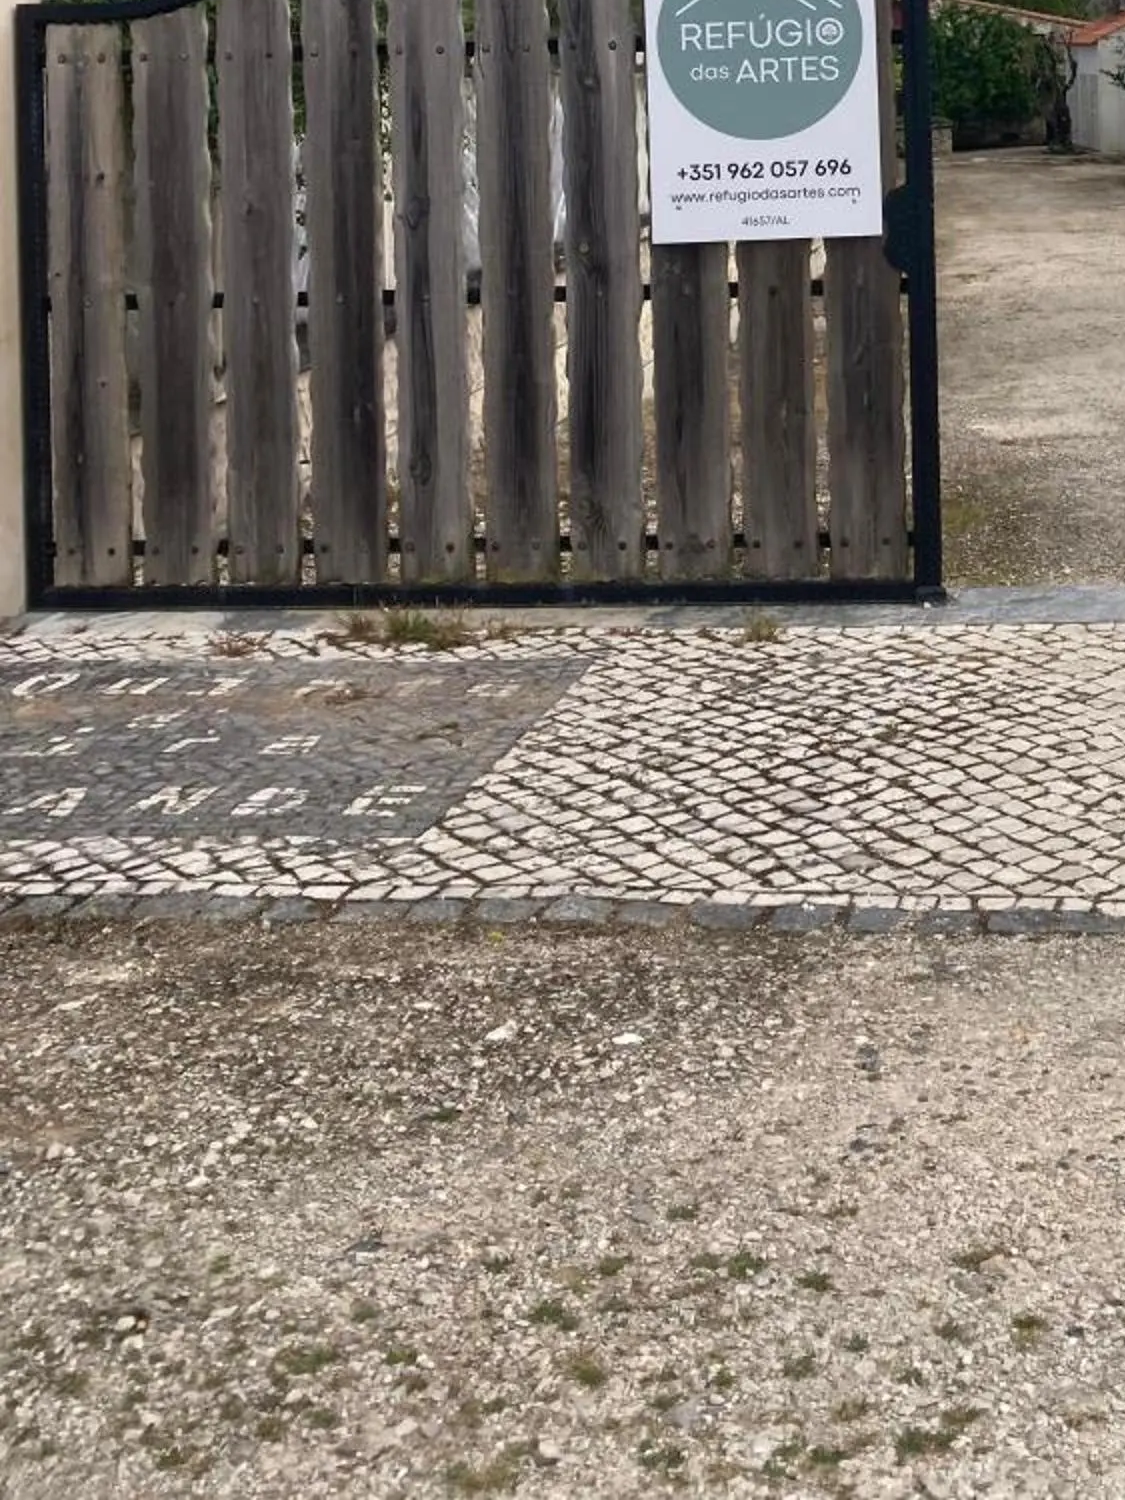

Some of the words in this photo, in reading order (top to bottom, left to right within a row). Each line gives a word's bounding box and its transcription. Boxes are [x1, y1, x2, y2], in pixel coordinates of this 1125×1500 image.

[680, 13, 844, 51] REFÚGIO
[690, 63, 729, 81] das
[735, 55, 840, 84] ARTES
[677, 163, 722, 181] +351
[727, 161, 765, 180] 962
[770, 160, 809, 178] 057
[814, 158, 852, 176] 696
[671, 185, 861, 204] www.refugiodasartes.com
